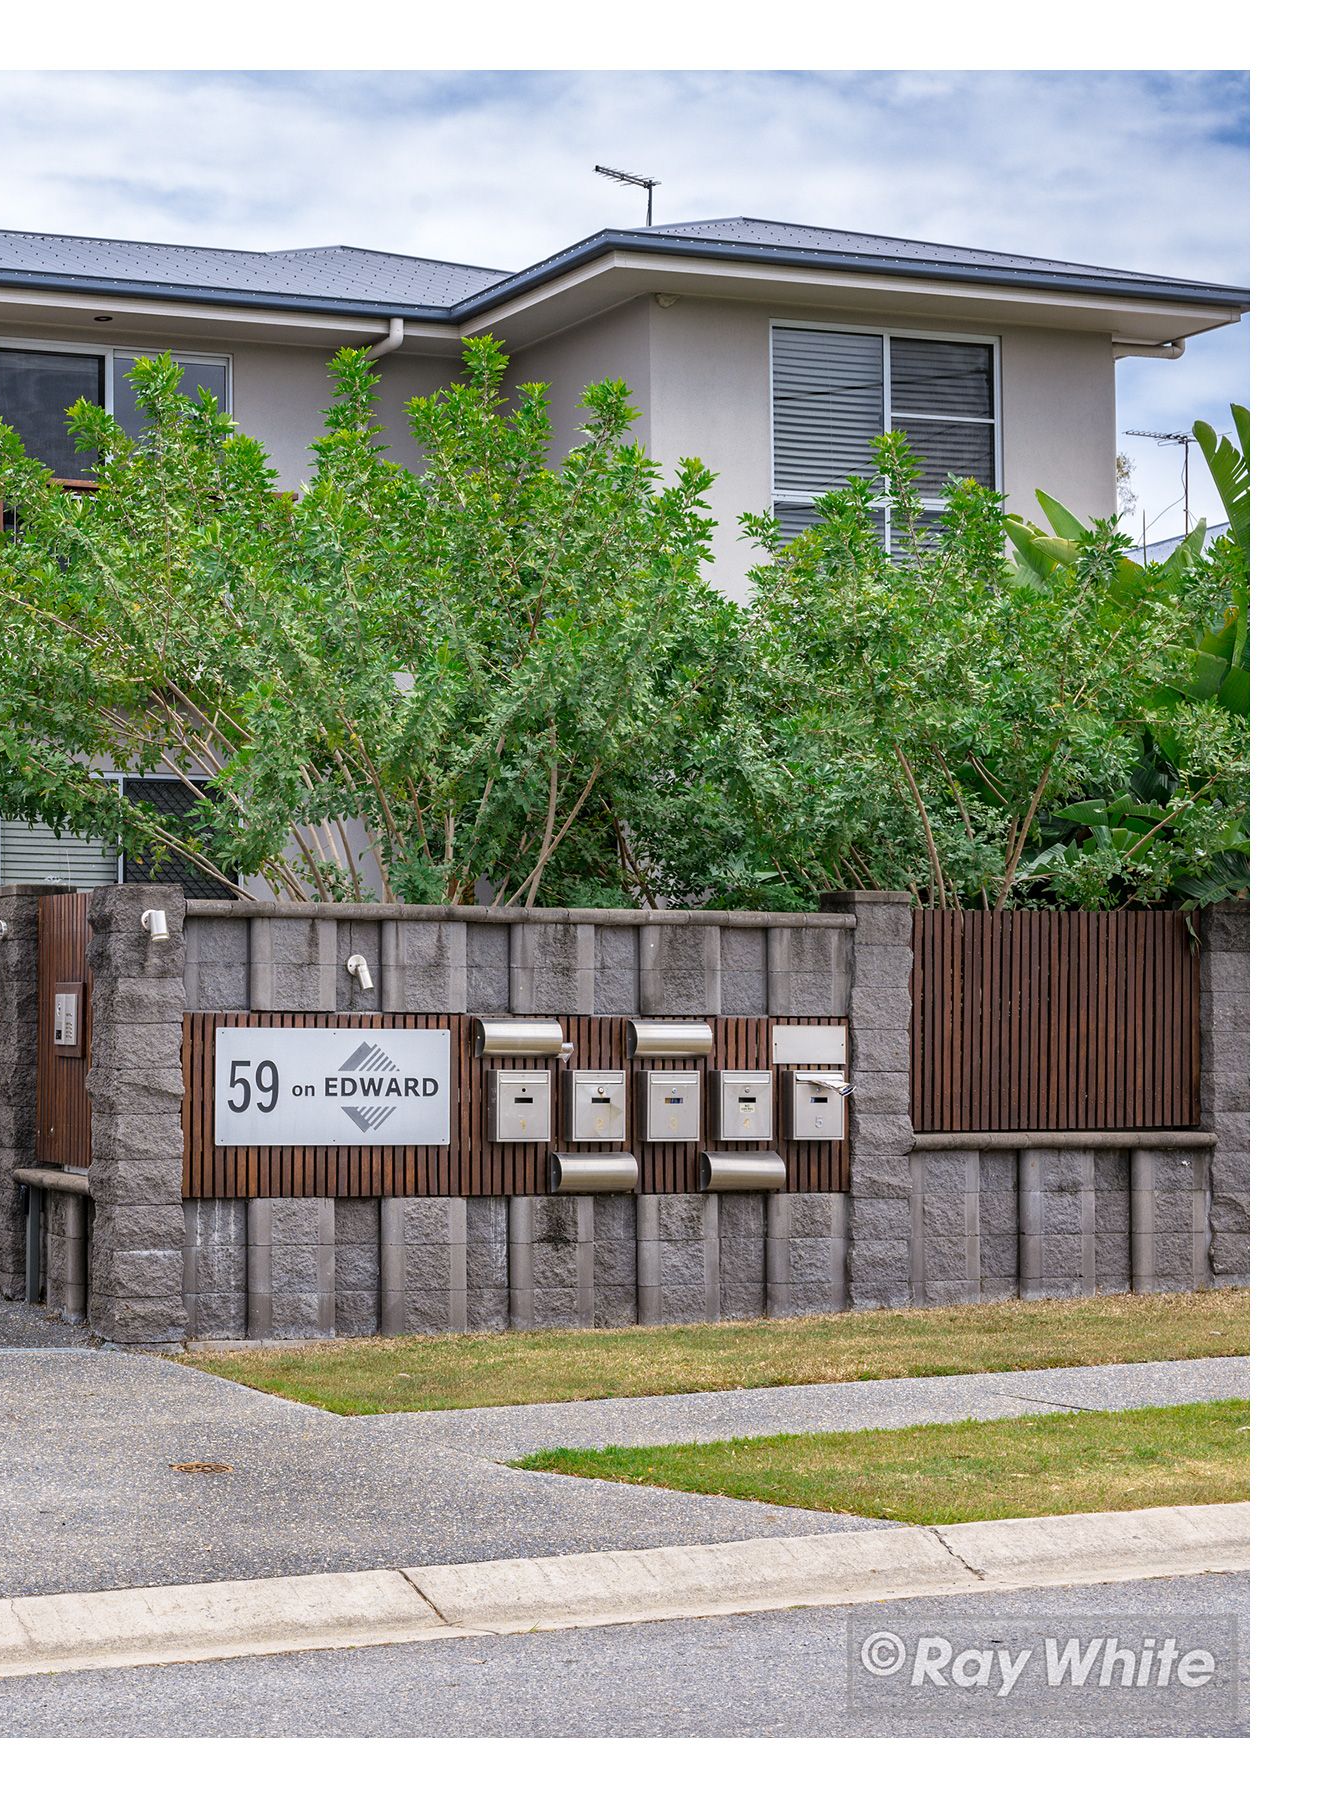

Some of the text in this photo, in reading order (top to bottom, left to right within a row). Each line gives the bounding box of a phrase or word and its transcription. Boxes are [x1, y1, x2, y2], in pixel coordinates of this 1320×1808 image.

[227, 1059, 439, 1113] 59 on EDWARD
[815, 1115, 824, 1129] 5
